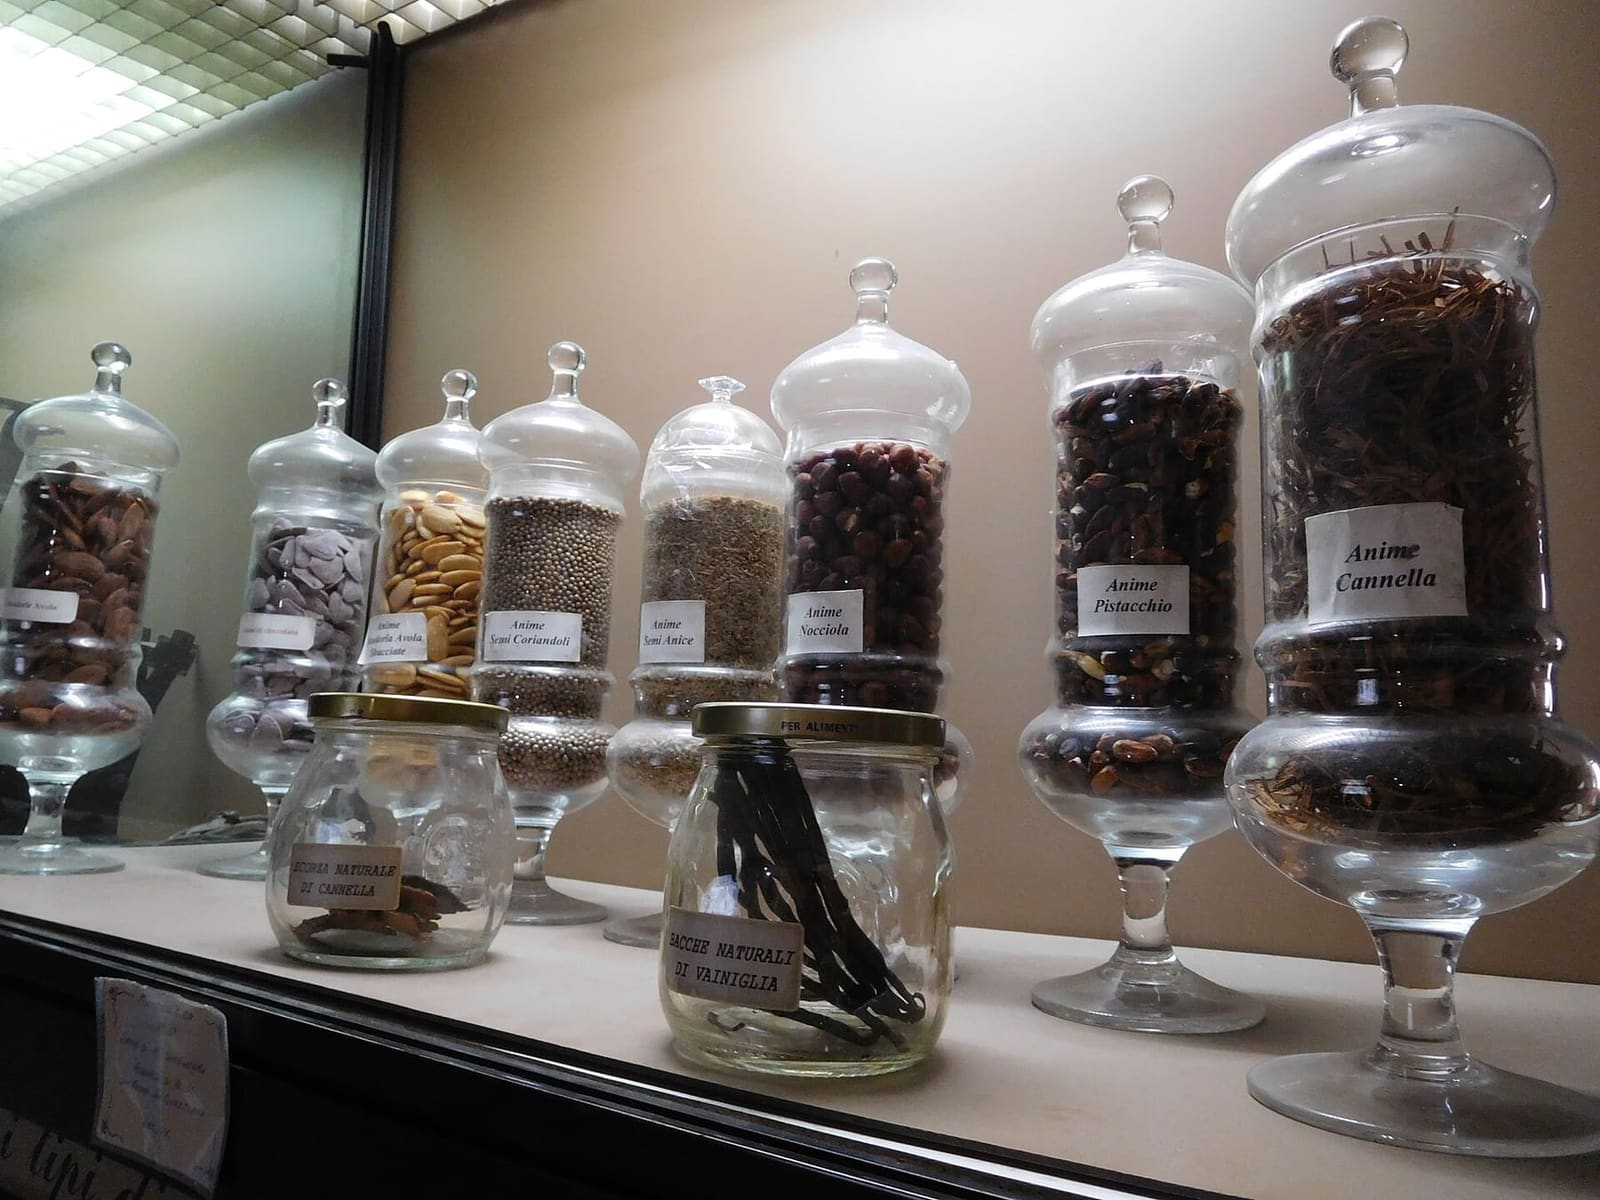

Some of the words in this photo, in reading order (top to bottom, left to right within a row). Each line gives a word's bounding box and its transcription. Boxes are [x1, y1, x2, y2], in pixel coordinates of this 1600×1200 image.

[1344, 541, 1421, 563] Anime
[1105, 578, 1158, 592] Anime
[1336, 568, 1436, 592] Cannella
[804, 605, 843, 618] Anime
[1094, 598, 1173, 613] Pistacchio
[510, 619, 546, 631] Anime
[650, 618, 682, 630] Anime
[800, 623, 849, 637] Nocciola
[396, 632, 423, 643] Avola
[490, 633, 512, 645] Semi
[513, 633, 571, 647] Coriandoli
[643, 634, 662, 646] Semi
[662, 634, 694, 646] Anice
[781, 720, 801, 732] PER
[334, 864, 397, 877] NATURALE
[301, 881, 314, 894] DI
[318, 882, 376, 897] CANNELLA
[669, 932, 710, 955] BACCHE
[716, 942, 796, 966] NATURALI
[675, 961, 690, 977] DI
[696, 966, 778, 993] VAINIGLIA
